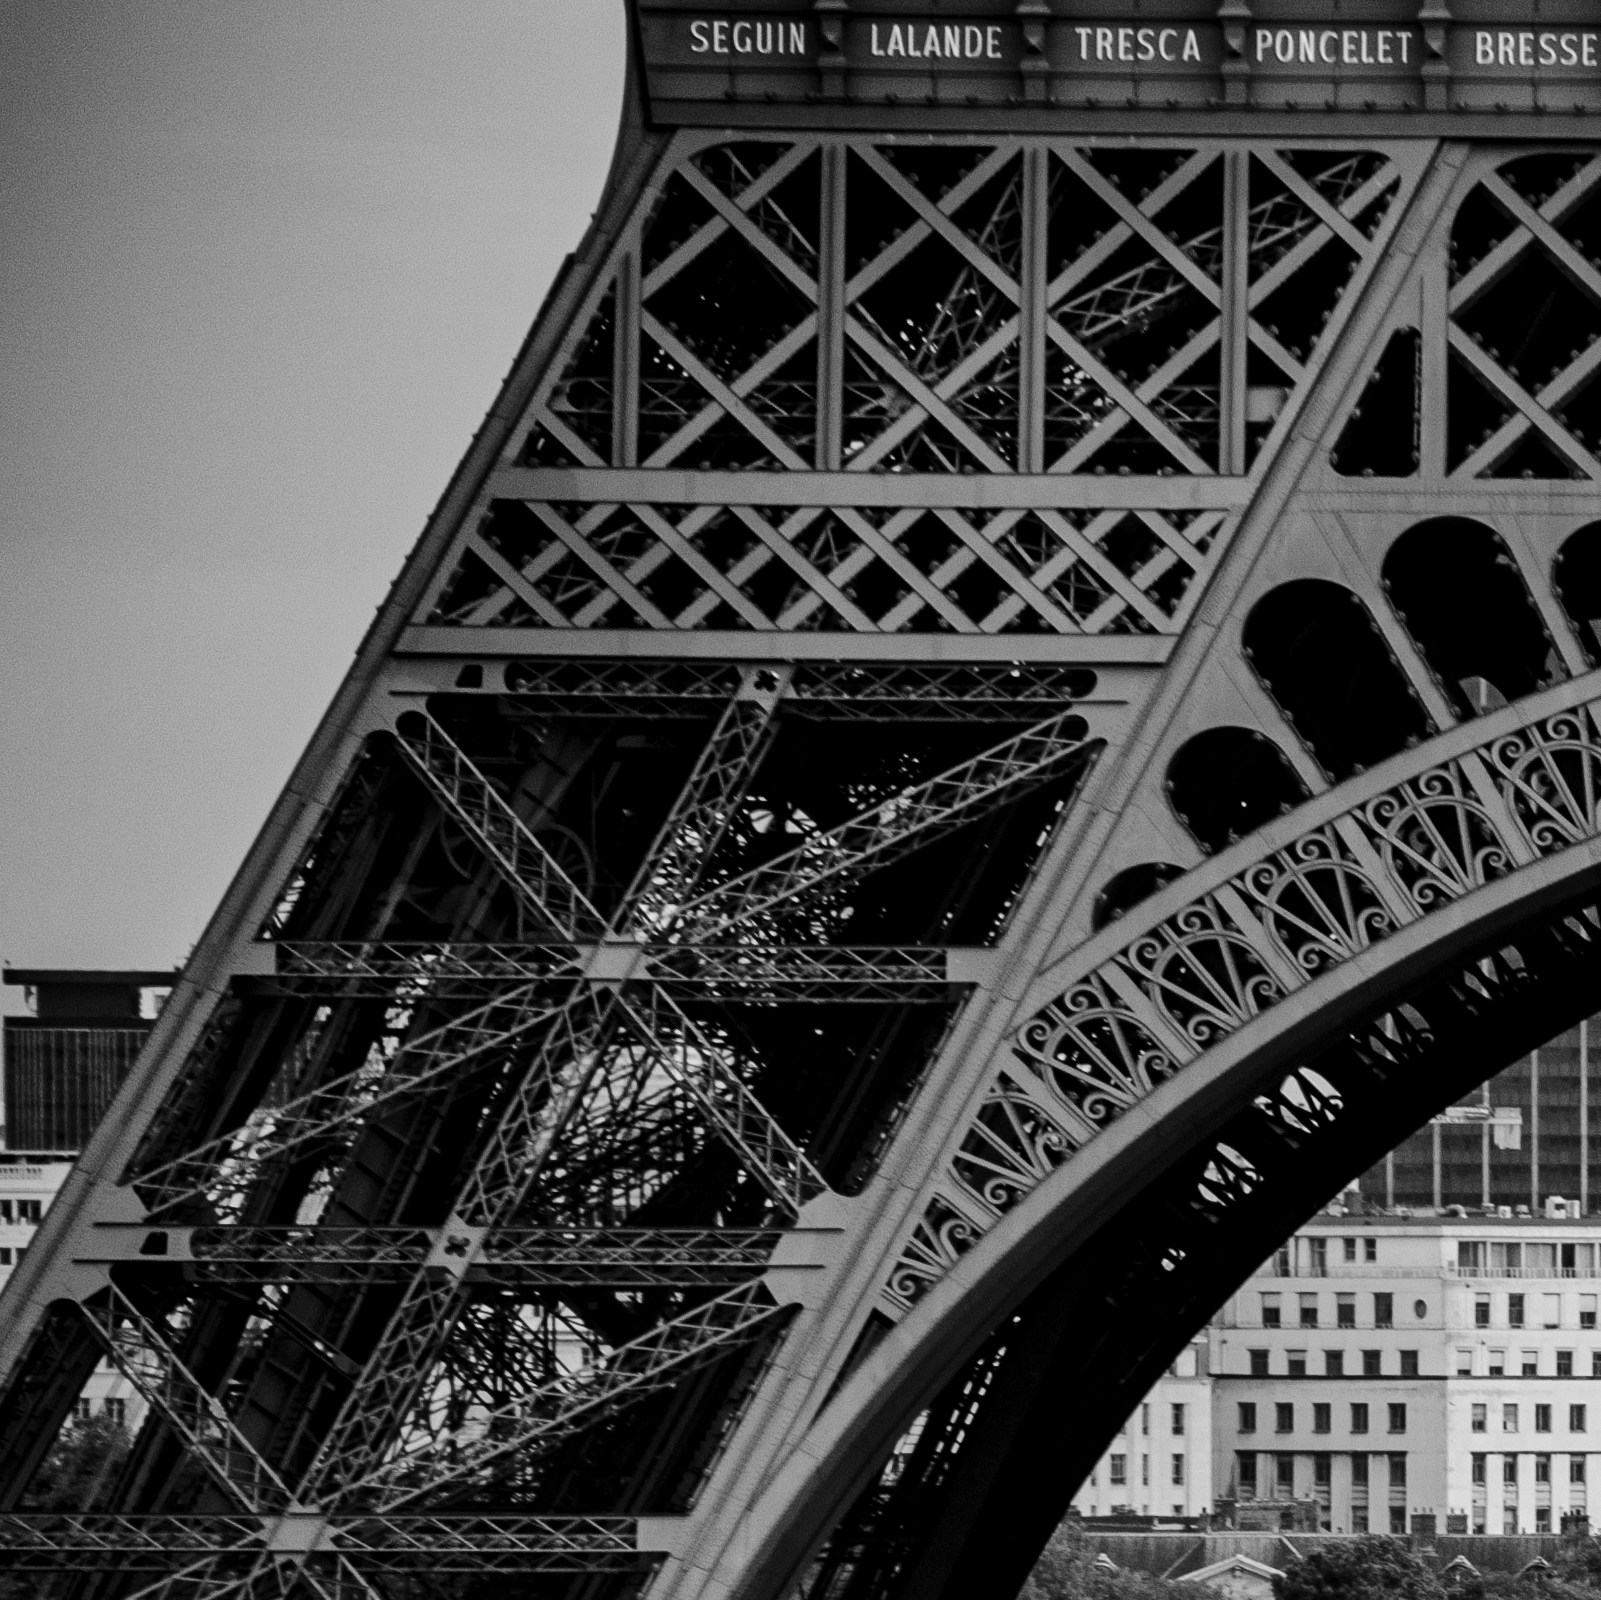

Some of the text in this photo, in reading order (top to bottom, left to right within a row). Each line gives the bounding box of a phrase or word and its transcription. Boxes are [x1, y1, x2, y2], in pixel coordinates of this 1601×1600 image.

[690, 21, 805, 54] SEGUIN
[871, 24, 1002, 58] LALANDE
[1075, 27, 1201, 61] TRESCA
[1256, 29, 1412, 63] PONCELET
[1476, 32, 1597, 66] BRESSE
